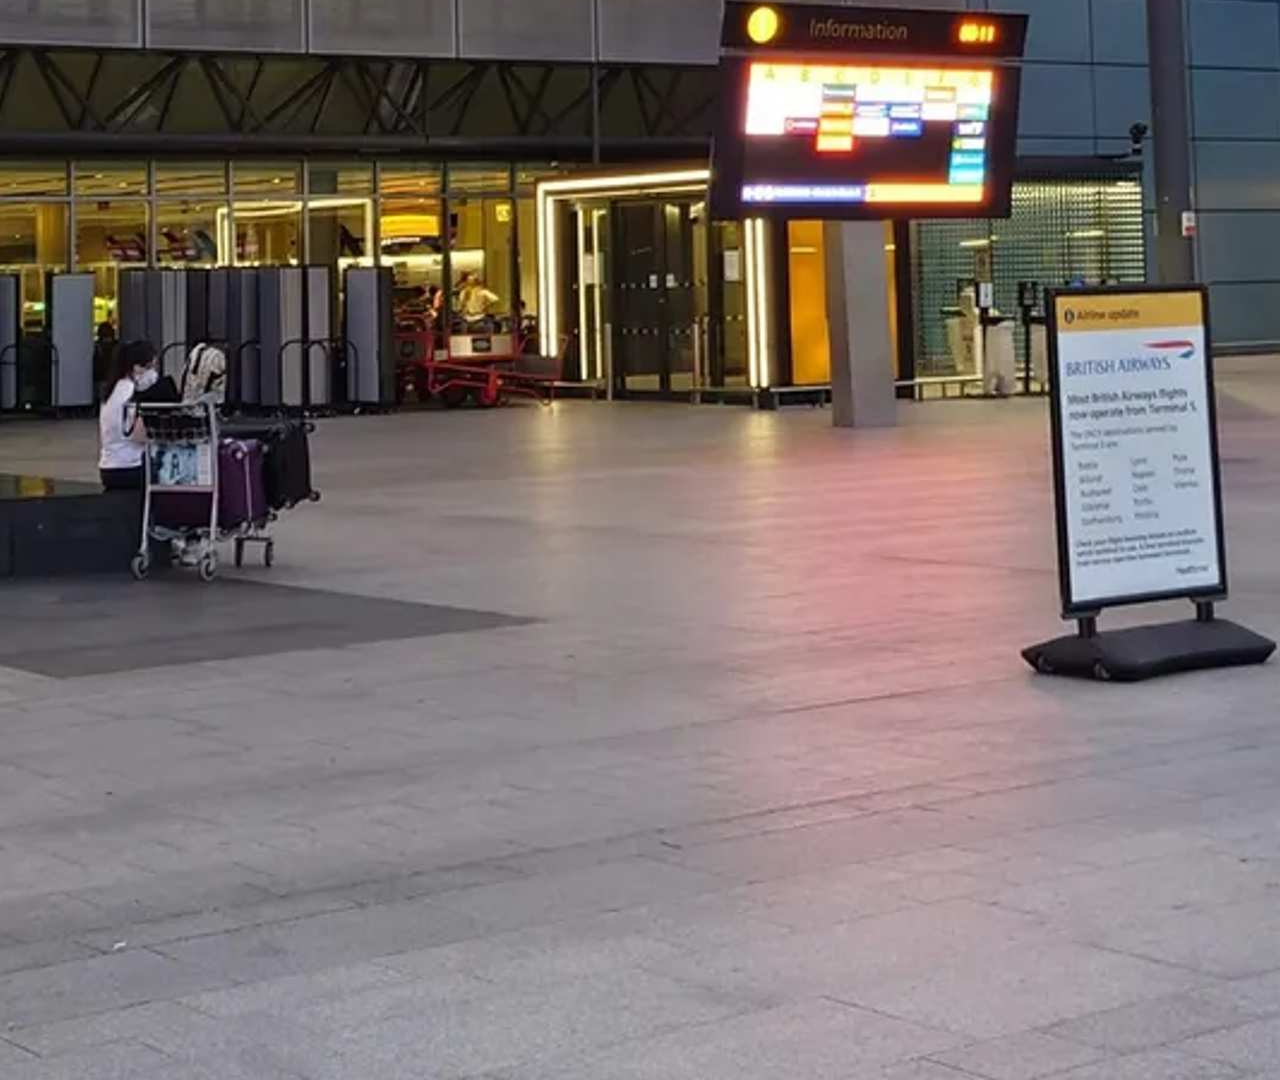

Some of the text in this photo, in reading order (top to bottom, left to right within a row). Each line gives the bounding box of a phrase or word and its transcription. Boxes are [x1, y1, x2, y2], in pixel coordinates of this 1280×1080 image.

[809, 18, 909, 41] Information
[1077, 308, 1140, 322] Airline update
[1066, 356, 1171, 378] BRITISH AIRWAYS
[1067, 387, 1188, 405] Most British Airways flights
[1090, 408, 1123, 420] operate
[1125, 405, 1147, 416] from
[1149, 401, 1188, 414] Terminal
